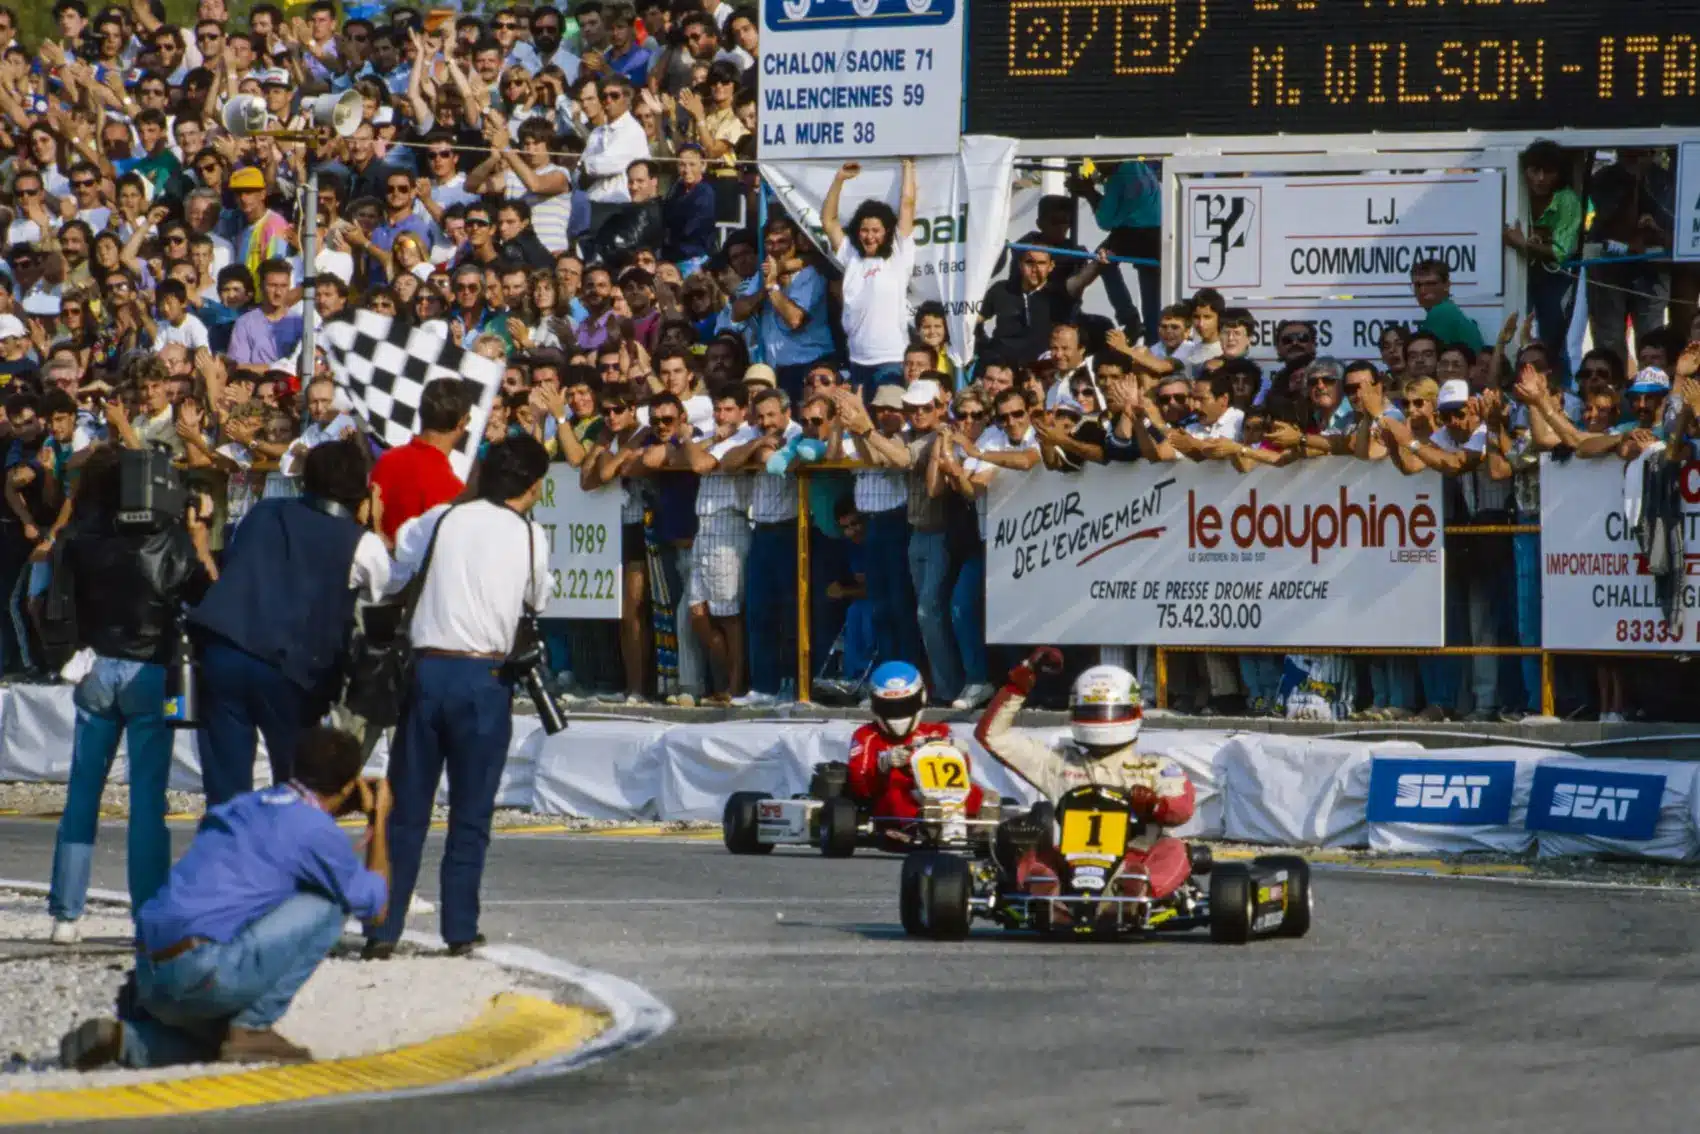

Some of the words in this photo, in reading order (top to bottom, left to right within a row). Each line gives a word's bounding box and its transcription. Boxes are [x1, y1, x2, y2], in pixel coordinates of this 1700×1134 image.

[915, 48, 934, 71] 71
[765, 85, 893, 111] VALENCIENNES
[903, 84, 925, 106] 59
[763, 123, 786, 145] LA
[795, 122, 844, 145] MURE
[853, 121, 876, 144] 38
[1290, 244, 1477, 275] COMMUNICATION
[994, 516, 1018, 549] AU
[1188, 488, 1224, 549] le
[568, 522, 606, 554] 1989
[1012, 544, 1038, 580] DE
[1546, 553, 1629, 576] IMPORTATEUR
[1090, 580, 1137, 600] CENTRE
[1142, 581, 1160, 600] DE
[1165, 580, 1210, 600] PRESSE
[1215, 581, 1264, 600] DROME
[1268, 580, 1329, 600] ARDECHE
[1156, 603, 1262, 629] 75.42.30.00
[926, 762, 964, 788] 12
[1395, 774, 1491, 809] SEAT
[1549, 783, 1640, 821] SEAT
[1085, 814, 1104, 847] 1
